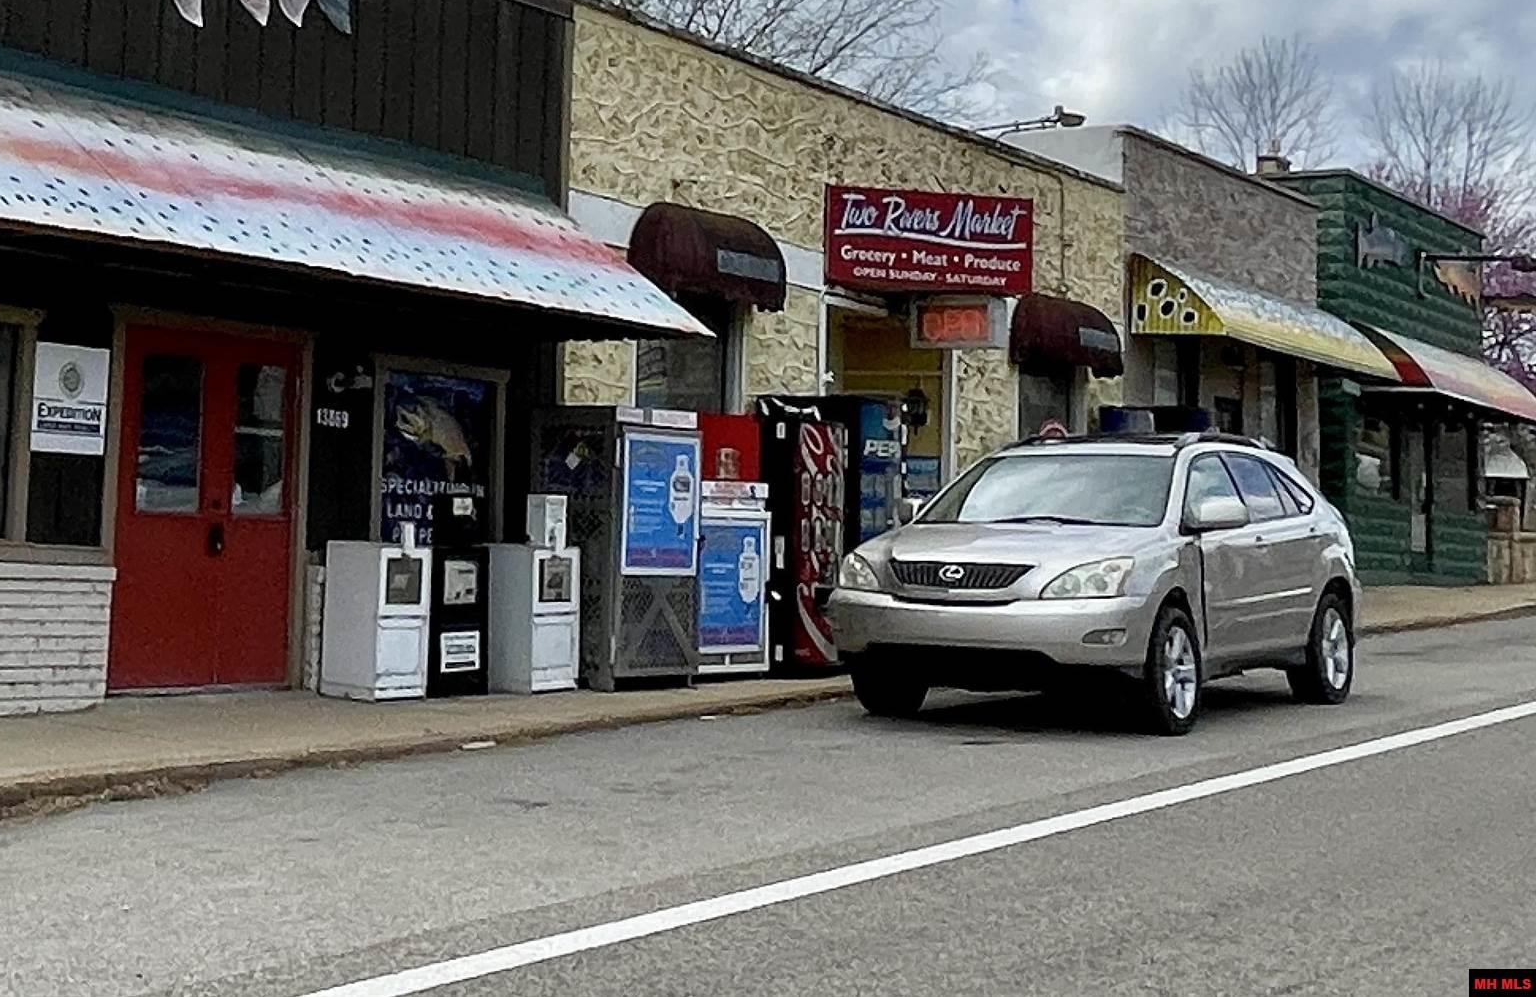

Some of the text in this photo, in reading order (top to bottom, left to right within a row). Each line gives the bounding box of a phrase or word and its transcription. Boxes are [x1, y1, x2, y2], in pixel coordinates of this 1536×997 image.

[841, 193, 1027, 240] Two Rivers Market
[840, 245, 1021, 272] Grocery Meat Produce
[853, 266, 886, 279] OPEN
[888, 269, 936, 282] SUNDAY
[945, 272, 1007, 287] SATURDAY
[864, 439, 901, 459] PEP
[386, 503, 423, 519] LAND
